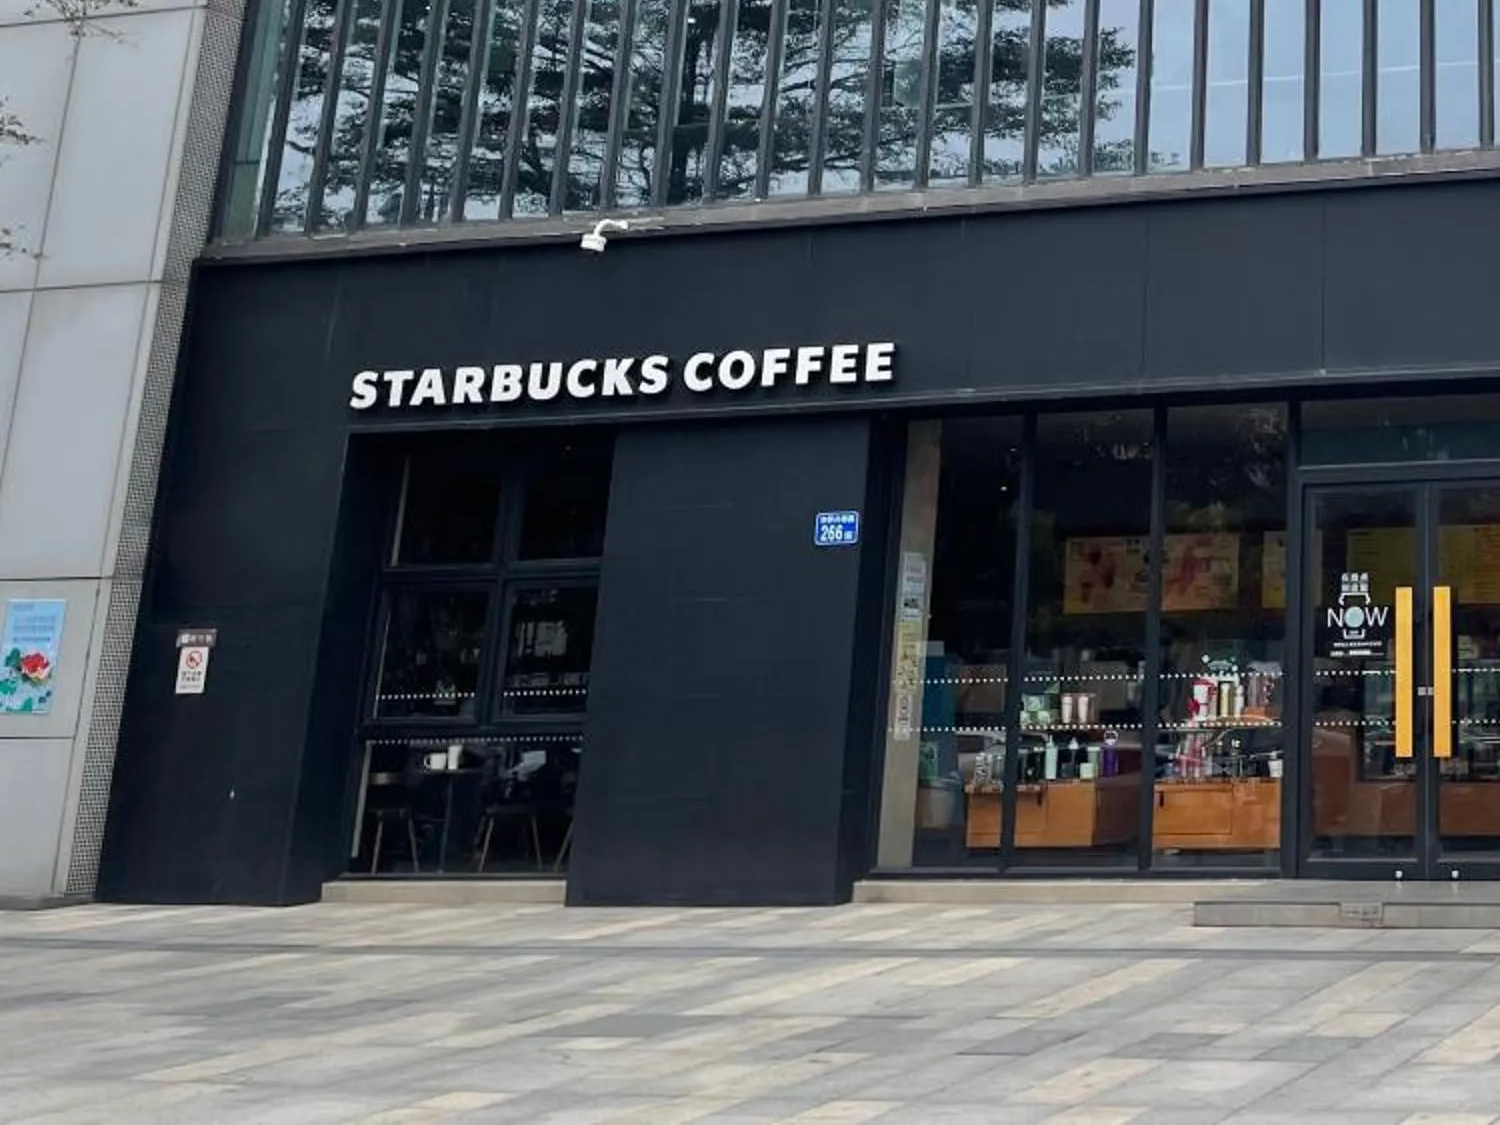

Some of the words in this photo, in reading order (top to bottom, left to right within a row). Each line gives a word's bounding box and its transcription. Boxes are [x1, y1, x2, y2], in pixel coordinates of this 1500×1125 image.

[350, 354, 669, 409] STARBUCKS
[683, 342, 895, 392] COFFEE
[820, 524, 843, 541] 266
[1327, 606, 1389, 628] NOW
